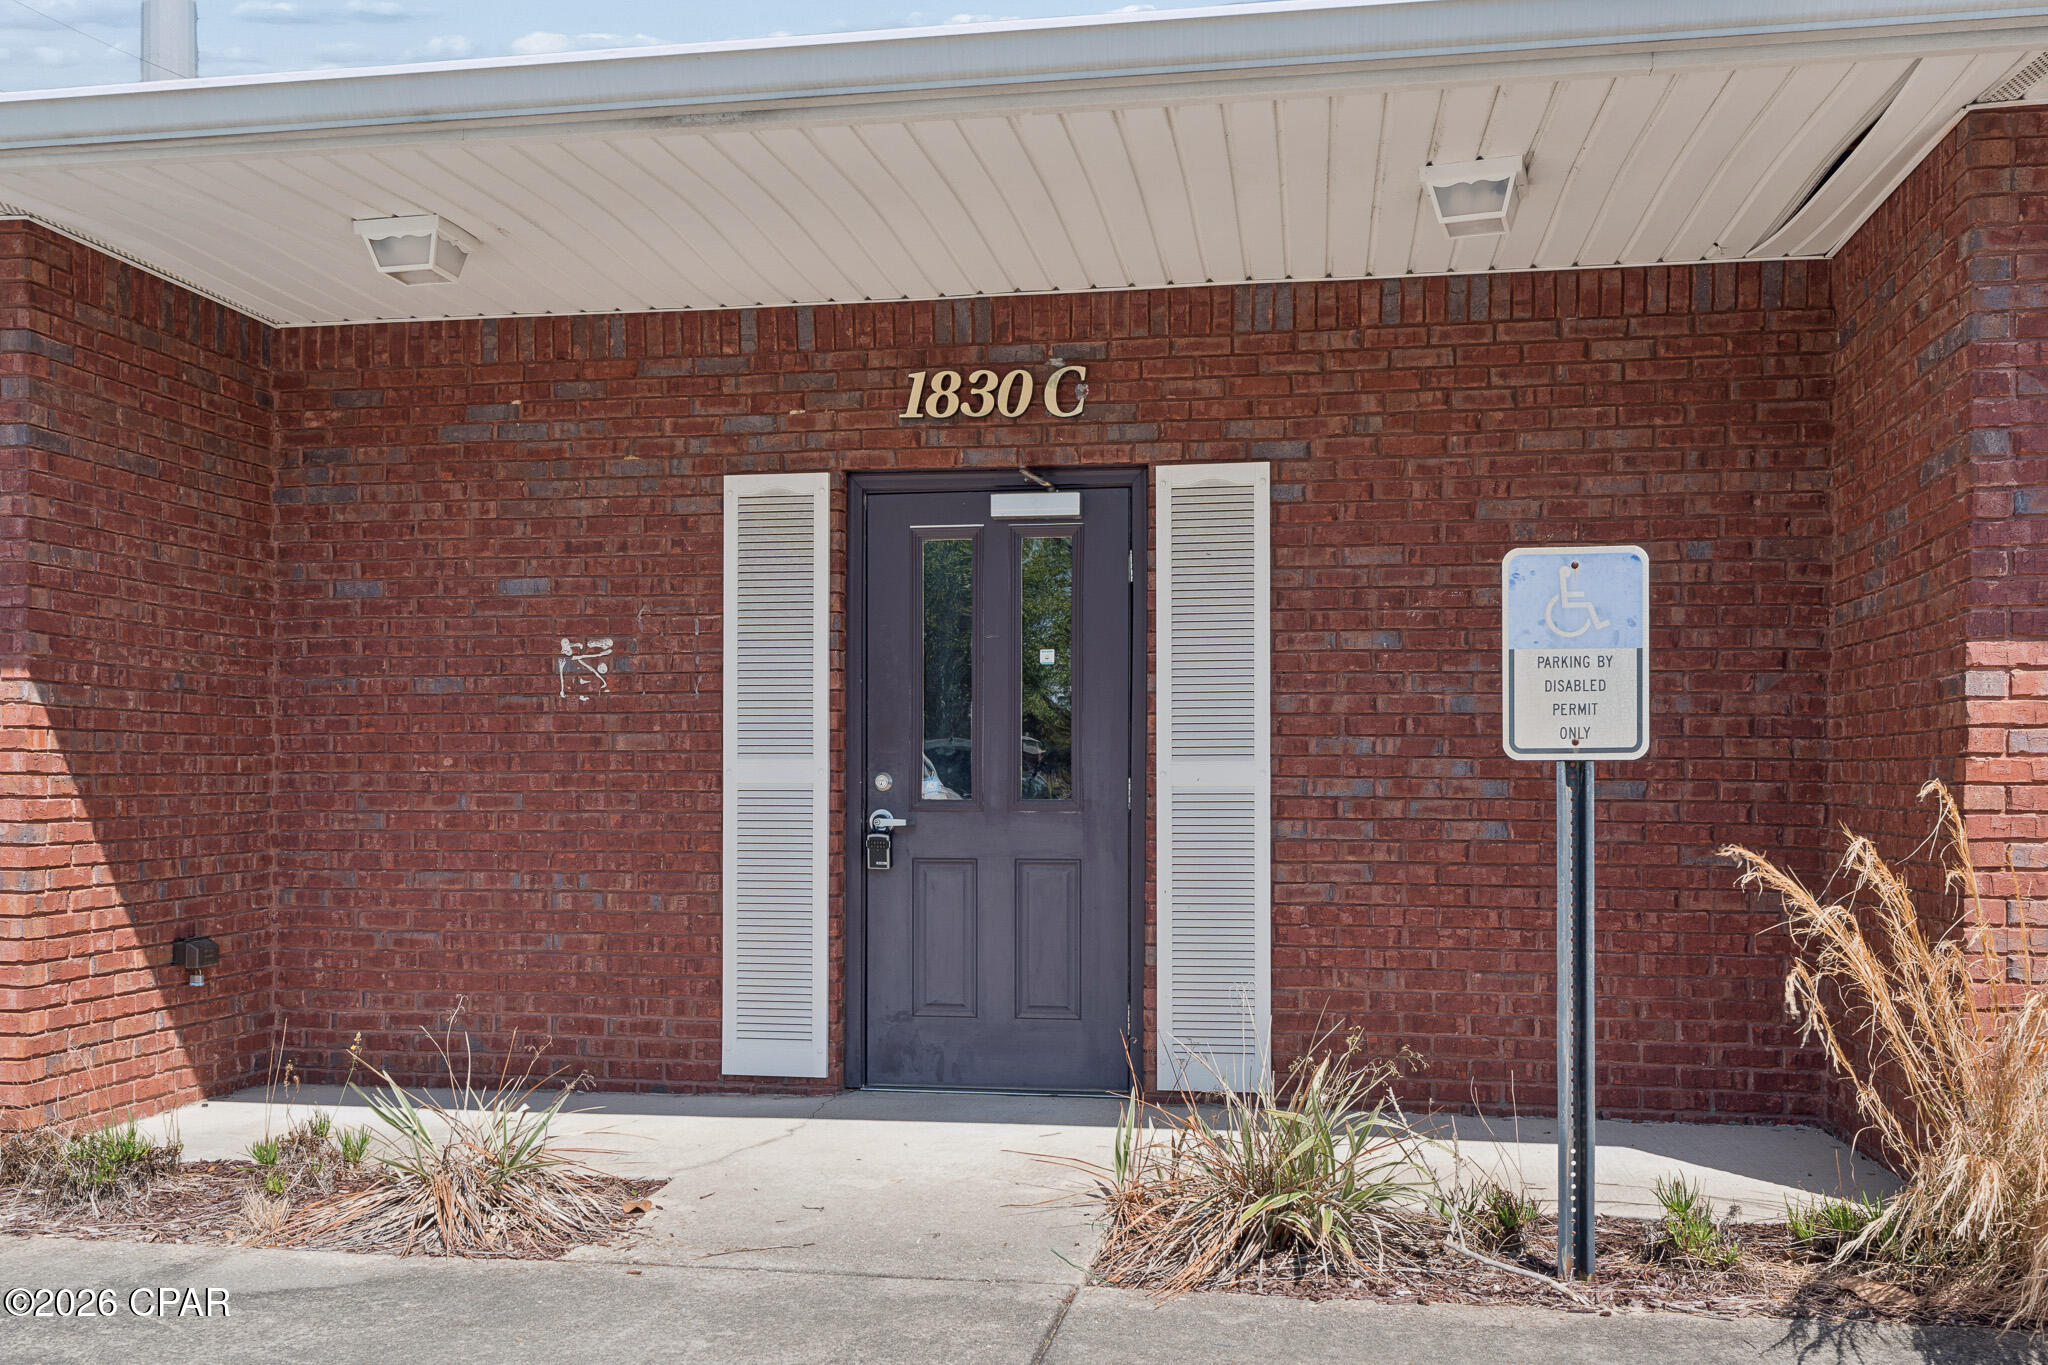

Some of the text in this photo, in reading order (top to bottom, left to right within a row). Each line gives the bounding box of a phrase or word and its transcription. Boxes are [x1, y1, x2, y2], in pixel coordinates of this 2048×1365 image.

[898, 365, 1087, 419] 1830 C
[1537, 655, 1613, 669] PARKING BY
[1544, 679, 1607, 692] DISABLED
[1552, 702, 1599, 716] PERMIT
[1559, 726, 1591, 740] ONLY
